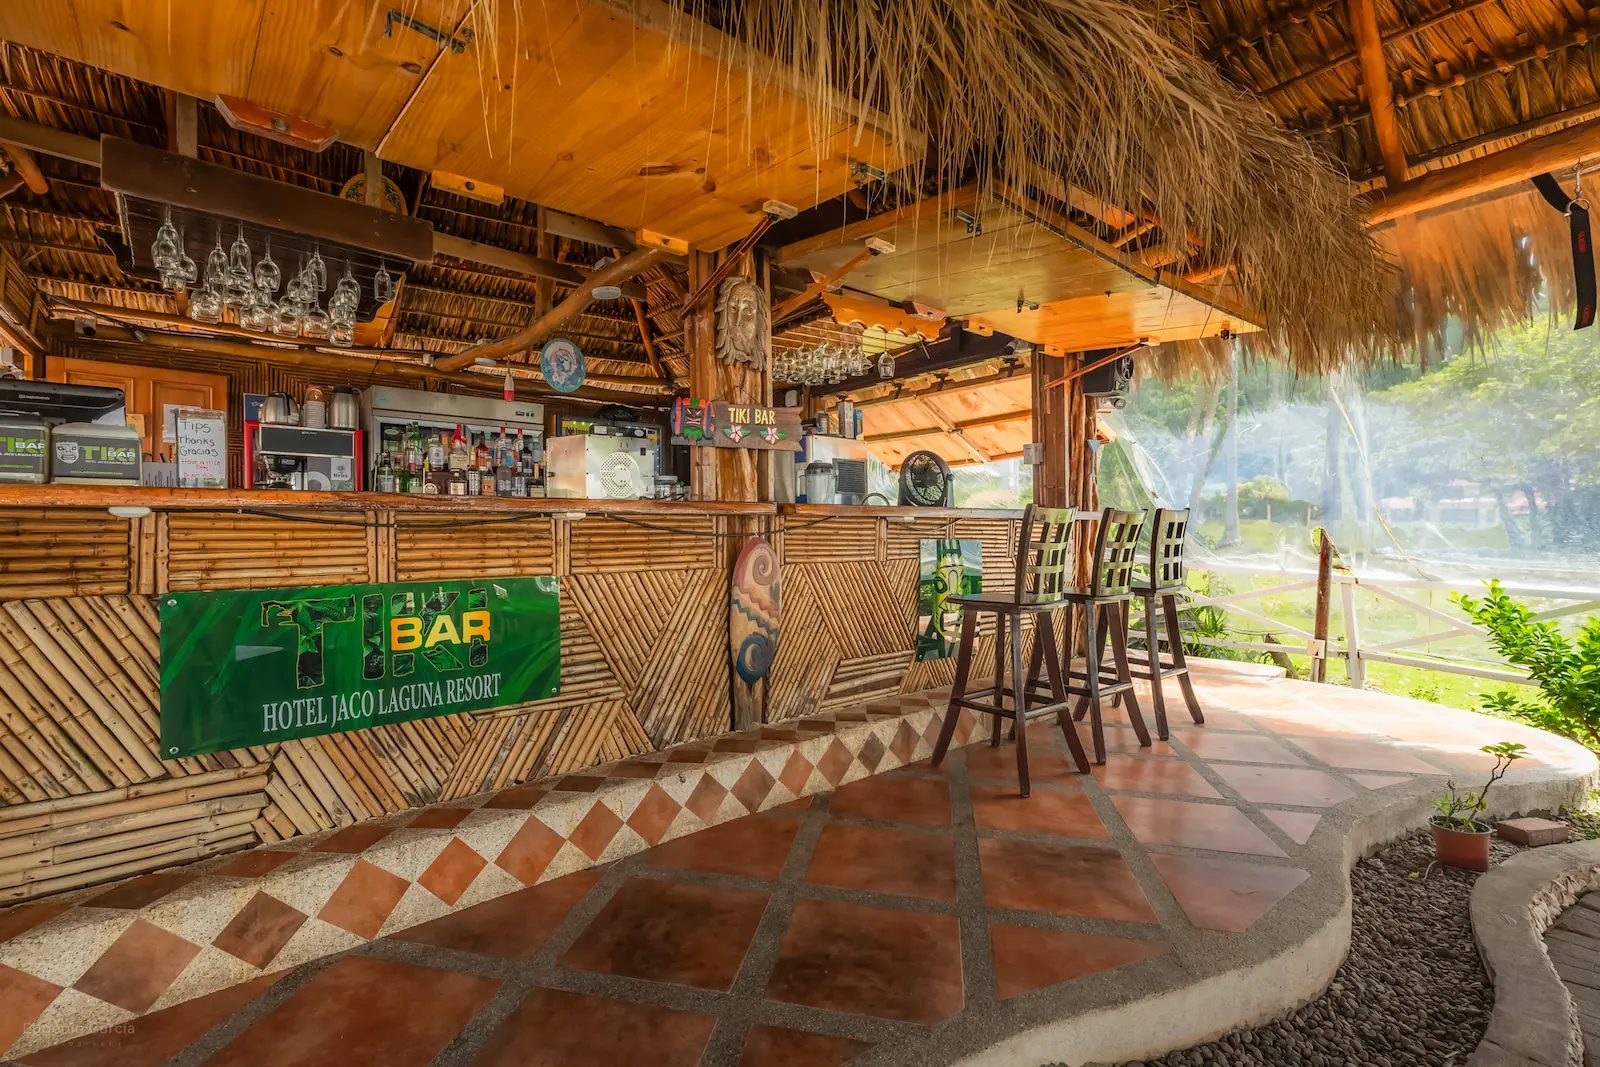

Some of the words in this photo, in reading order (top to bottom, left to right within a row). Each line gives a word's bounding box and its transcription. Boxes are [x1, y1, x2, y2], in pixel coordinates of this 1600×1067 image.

[728, 407, 750, 424] TIKI
[754, 409, 776, 424] BAR
[179, 435, 215, 447] Thanks
[179, 446, 219, 458] Gracias
[262, 588, 488, 690] TIKI
[391, 610, 491, 651] BAR
[263, 697, 328, 732] HOTEL
[331, 690, 374, 728] JACO
[378, 681, 443, 715] LAGUNA
[446, 673, 501, 704] RESORT
